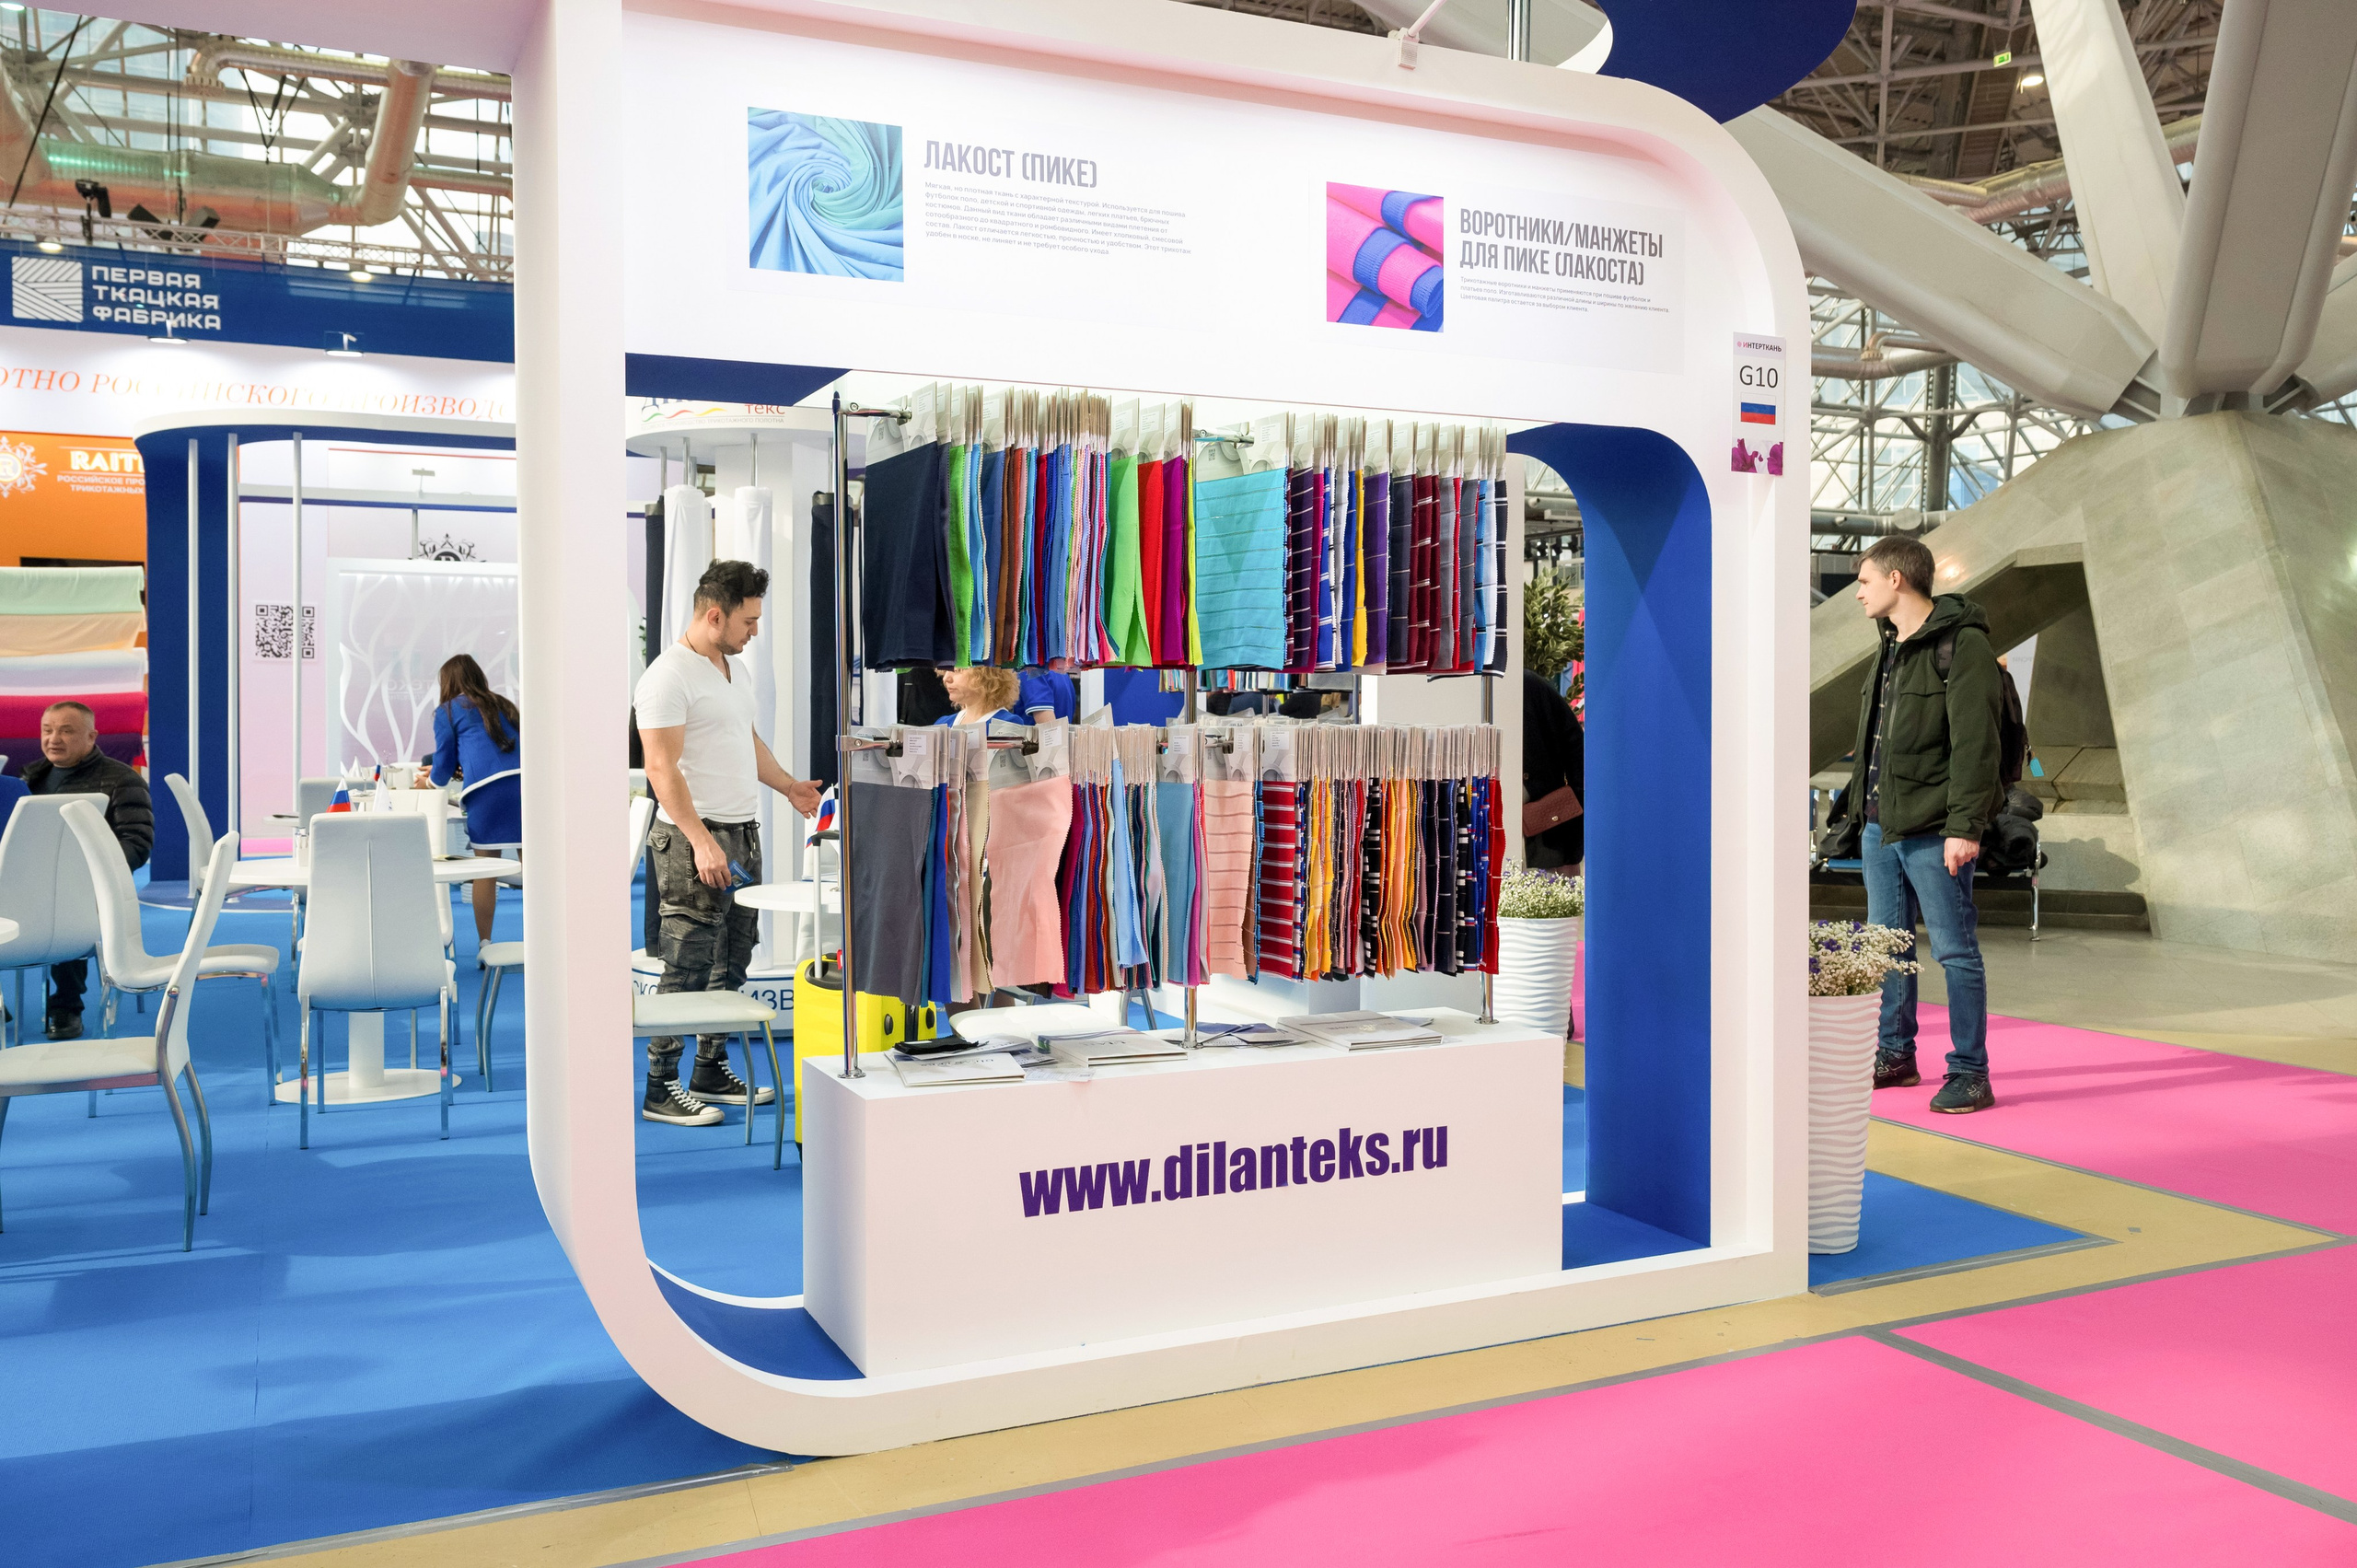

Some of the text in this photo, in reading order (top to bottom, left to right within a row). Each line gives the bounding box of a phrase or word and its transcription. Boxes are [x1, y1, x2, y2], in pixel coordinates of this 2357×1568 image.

[924, 140, 1097, 188] ЛАКОСТ (ПИКЕ)
[924, 181, 953, 192] Мягкая,
[964, 187, 993, 195] плотная
[1019, 193, 1064, 203] характерной
[1064, 199, 1101, 209] текстурой.
[1101, 202, 1148, 214] Используется
[1161, 210, 1186, 218] пошива
[924, 192, 959, 201] футболок
[959, 196, 980, 204] поло,
[980, 198, 1009, 207] детской
[1015, 203, 1057, 212] спортивной
[1057, 207, 1086, 216] одежды,
[1110, 213, 1139, 223] платьев,
[1140, 215, 1170, 226] брючных
[924, 211, 980, 223] сотообразного
[989, 218, 1034, 228] квадратного
[1039, 224, 1090, 235] ромбовидного.
[1091, 228, 1112, 237] Имеет
[1113, 232, 1151, 241] хлопковый,
[1151, 236, 1183, 245] смесовой
[925, 202, 963, 211] костюмов.
[963, 204, 992, 215] Данный
[1027, 212, 1060, 222] обладает
[1060, 216, 1102, 226] различными
[1128, 225, 1160, 233] плетения
[1461, 208, 1663, 258] ВОРОТНИКИ/МАНЖЕТЫ
[925, 220, 952, 229] состав.
[952, 223, 978, 232] Лакост
[978, 226, 1019, 236] отличается
[1019, 231, 1058, 241] легкостью,
[1058, 235, 1100, 245] прочностью
[1106, 240, 1144, 250] удобством.
[1144, 243, 1160, 251] Этот
[1160, 246, 1191, 255] трикотаж
[925, 230, 952, 238] удобен
[958, 234, 981, 242] носке,
[1033, 241, 1061, 250] требует
[1061, 245, 1089, 253] особого
[92, 265, 201, 289] ПЕРВАЯ
[1460, 240, 1644, 285] ДЛЯ ПИКЕ (ЛАКОСТА)
[92, 285, 219, 309] ТКАЦКАЯ
[92, 306, 221, 331] ФАБРИКА
[1743, 342, 1782, 352] ИНТЕРТКАНЬ
[1739, 365, 1779, 388] G10
[57, 474, 123, 485] РОССИЙСКОЕ
[70, 484, 144, 494] ТРИКОТАЖНЫХ
[1019, 1125, 1448, 1217] www.dilanteks.ru
